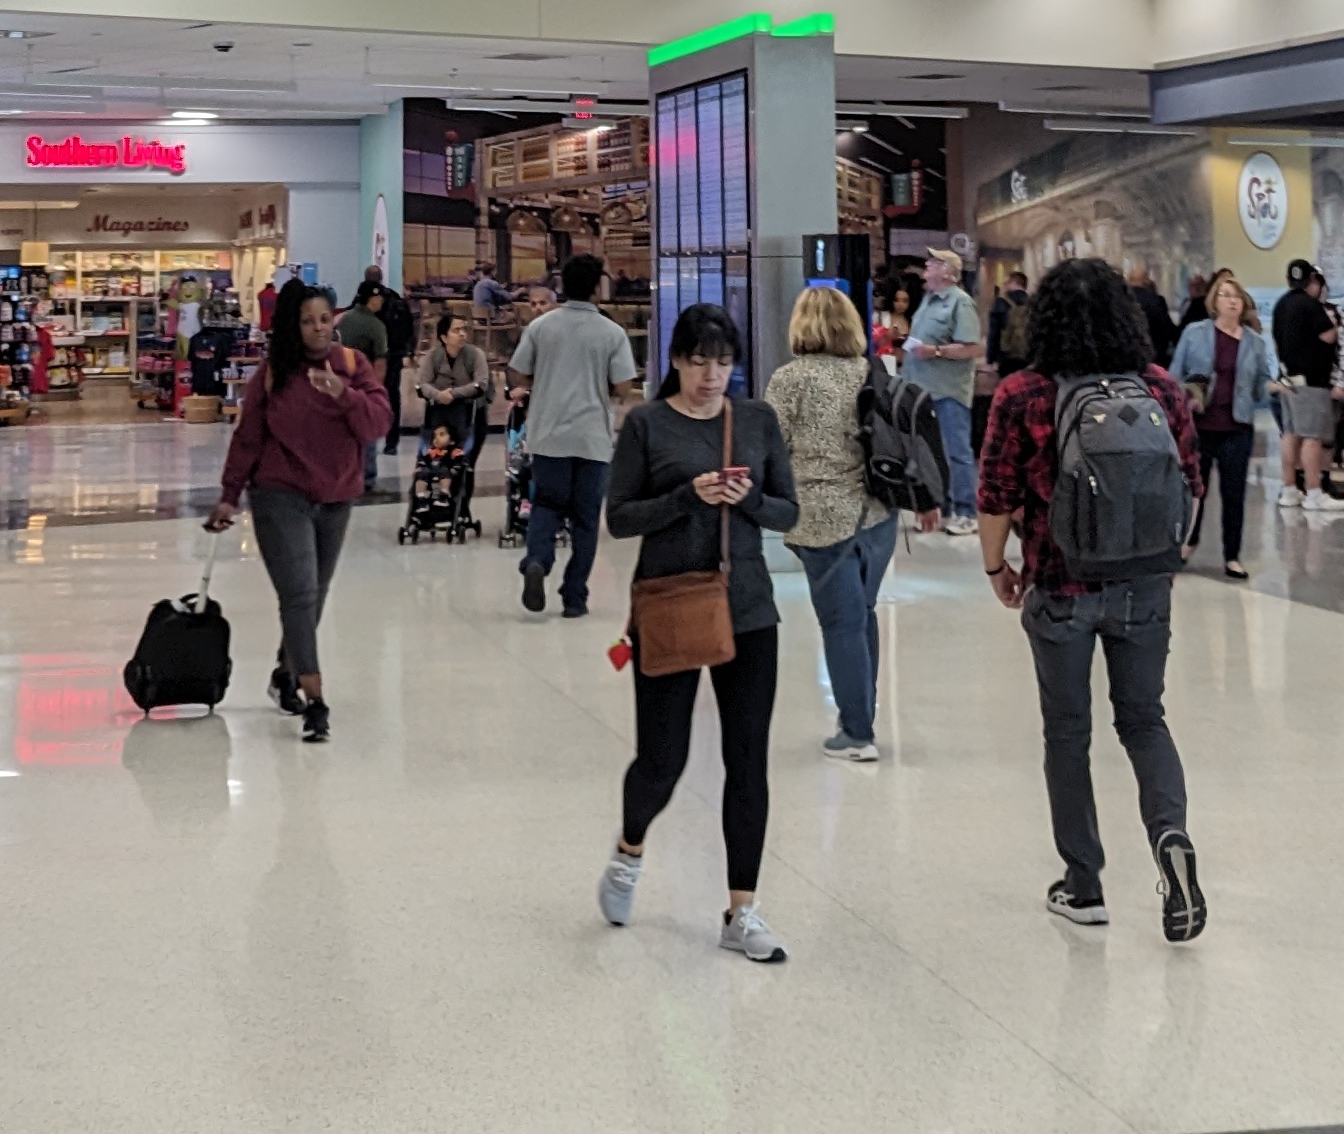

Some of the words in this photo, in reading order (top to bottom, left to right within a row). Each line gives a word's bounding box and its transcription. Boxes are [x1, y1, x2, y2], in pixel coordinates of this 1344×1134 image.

[26, 136, 119, 166] Southern
[122, 137, 186, 172] Living
[86, 215, 190, 237] Magazines
